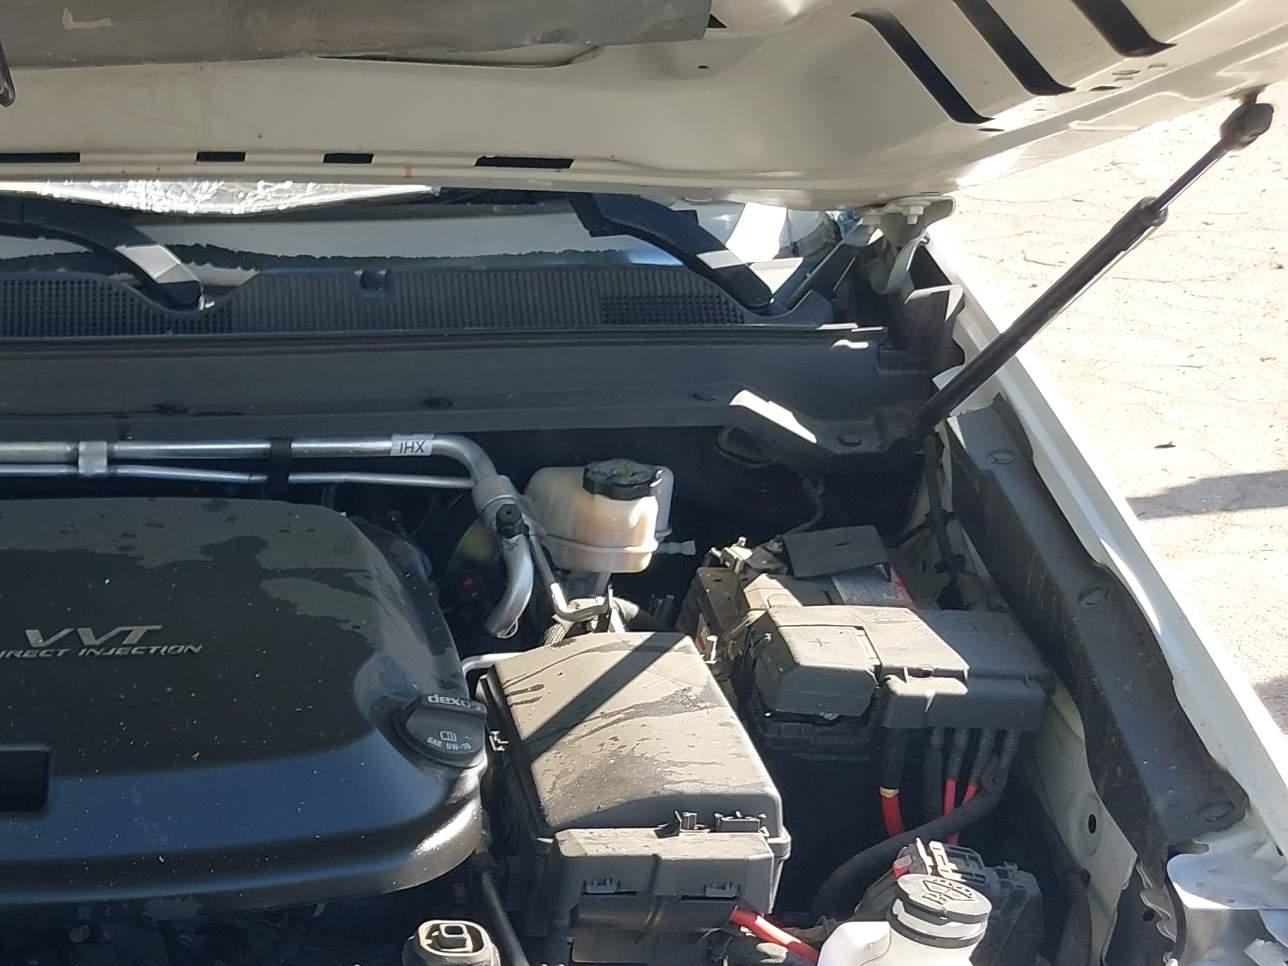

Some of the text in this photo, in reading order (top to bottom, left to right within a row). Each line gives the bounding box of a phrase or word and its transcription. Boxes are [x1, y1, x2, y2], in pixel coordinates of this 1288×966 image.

[399, 441, 425, 454] IHX
[25, 625, 162, 648] VVT
[78, 644, 203, 656] INJECTION
